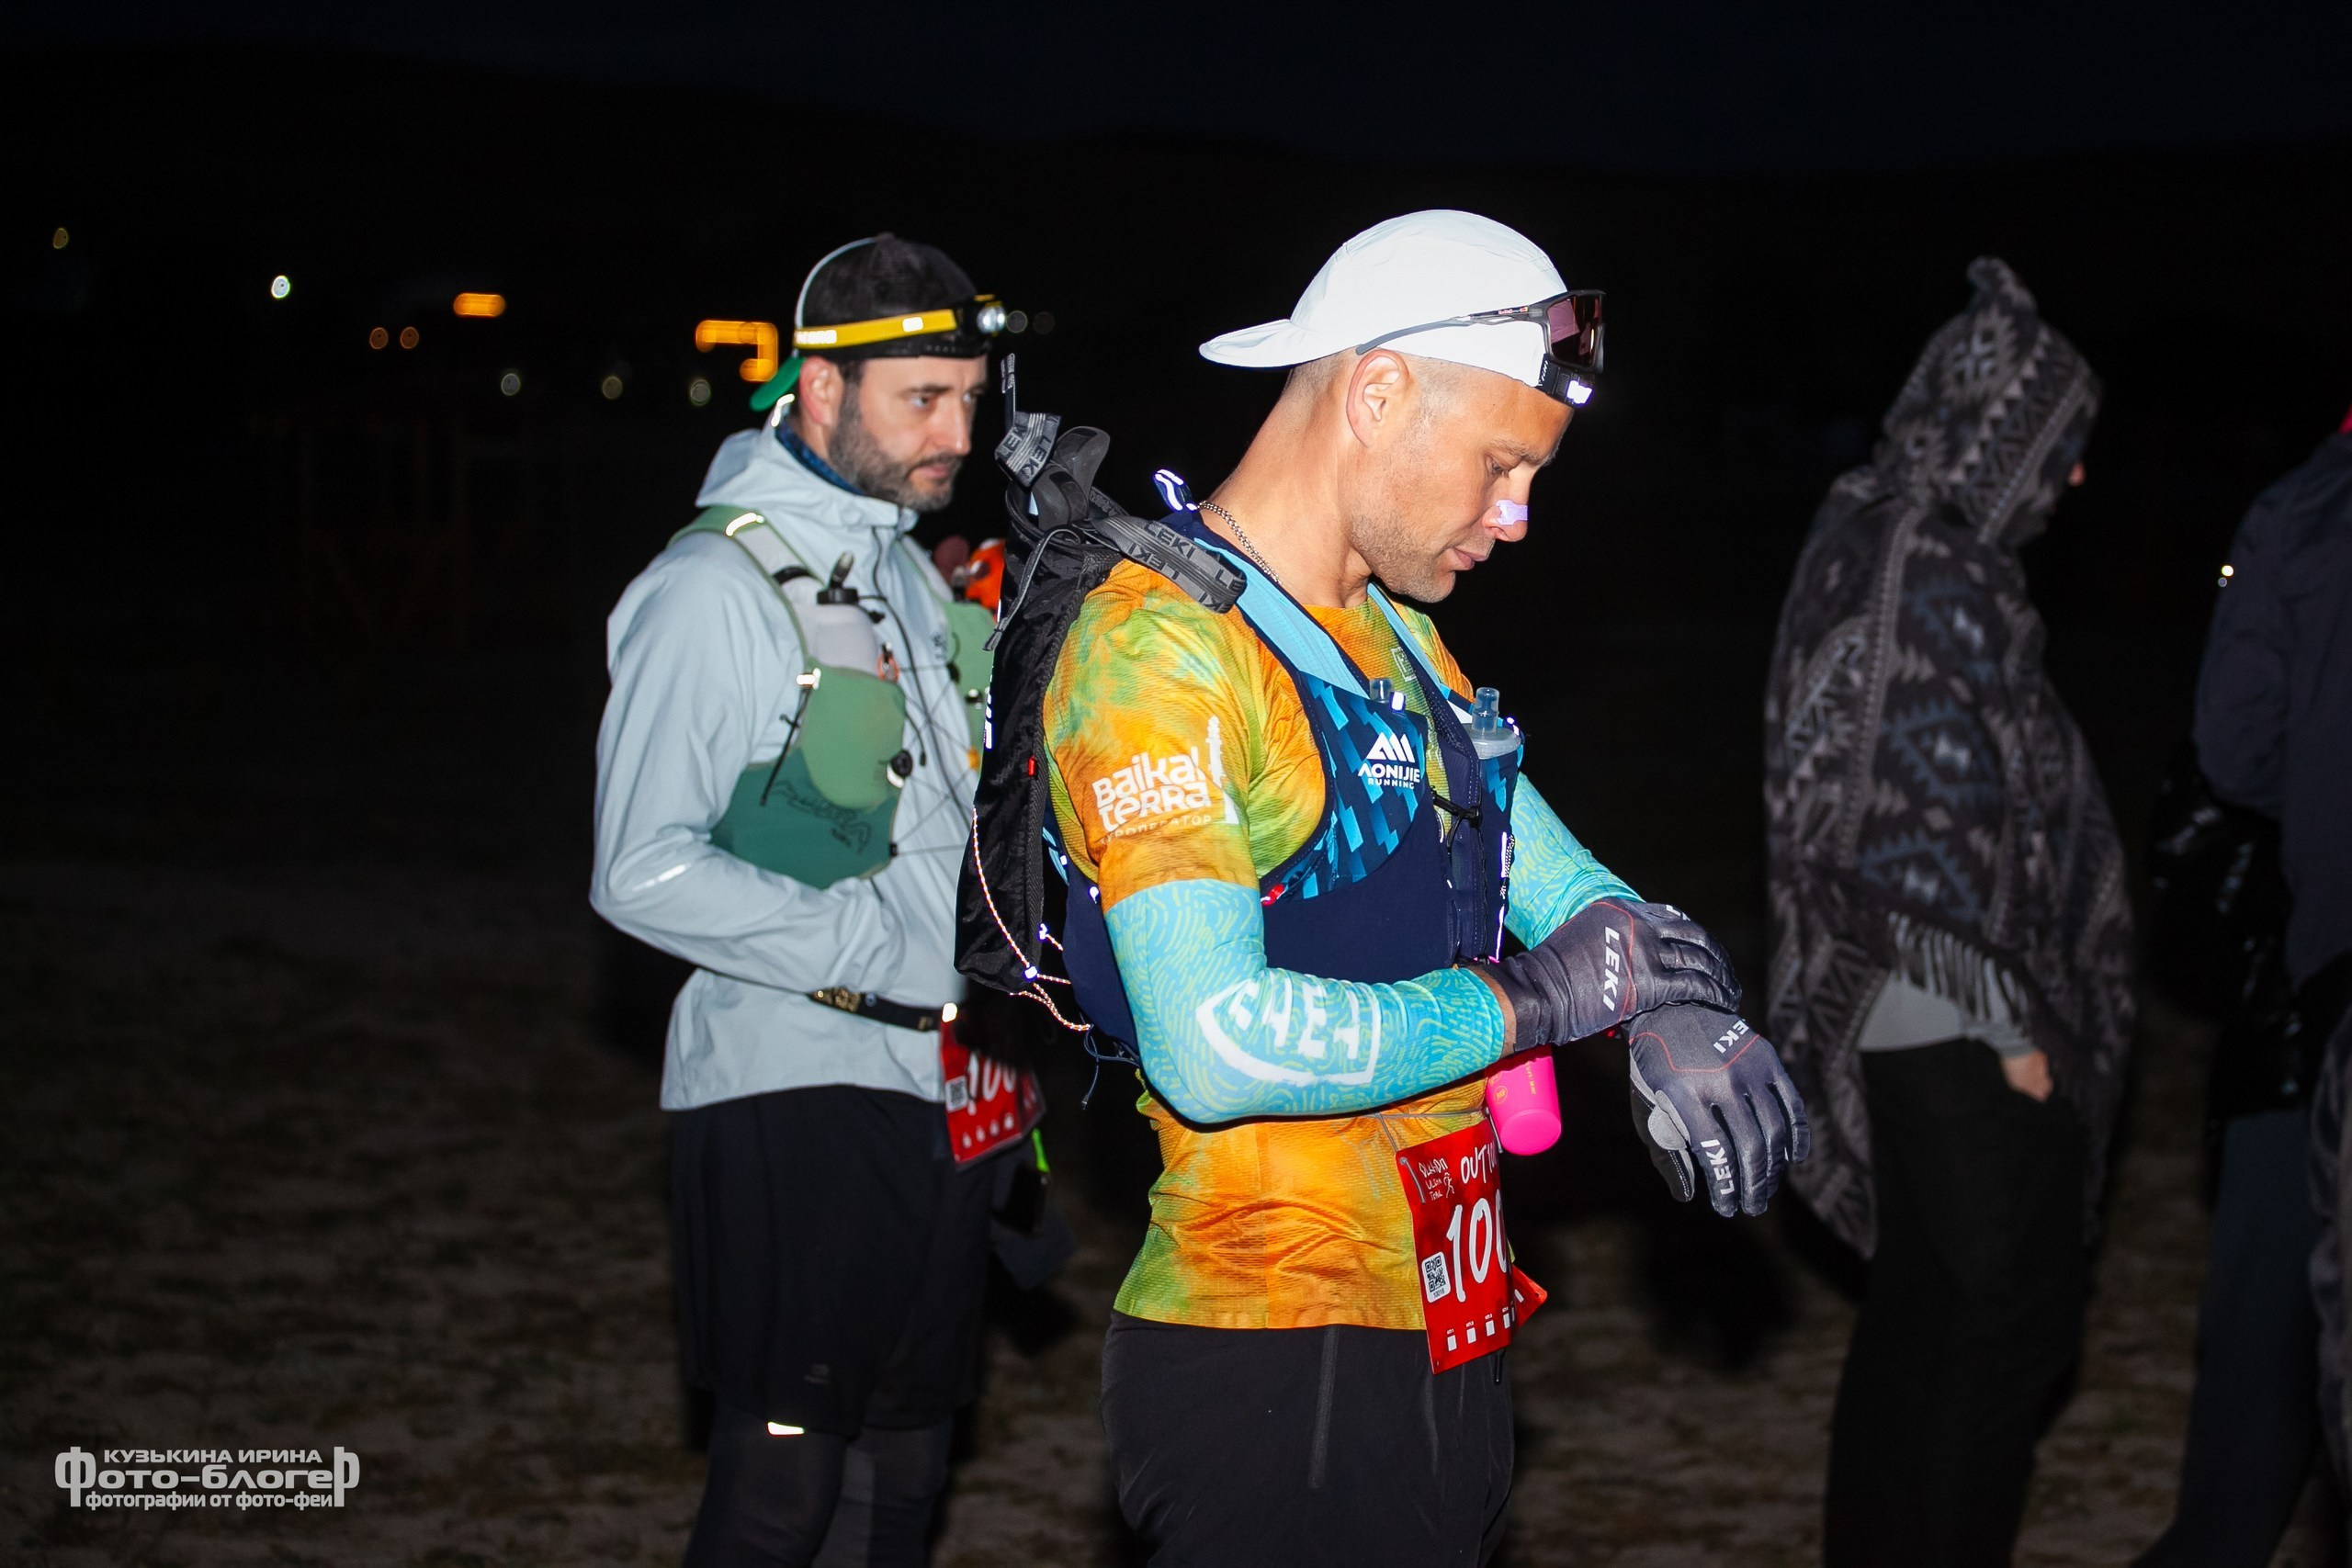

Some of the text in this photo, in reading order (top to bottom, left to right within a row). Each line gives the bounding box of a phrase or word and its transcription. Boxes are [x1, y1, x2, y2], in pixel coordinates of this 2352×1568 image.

[1144, 521, 1195, 559] LEKI
[1127, 543, 1181, 581] LEKI
[1091, 746, 1207, 809] Baikal
[1357, 762, 1420, 783] AONIJIE
[1367, 777, 1415, 790] RUNNING
[1602, 926, 1621, 1011] LEKI
[1713, 1019, 1749, 1054] EKI
[1460, 1144, 1487, 1184] OUT
[1701, 1139, 1736, 1195] LEKI
